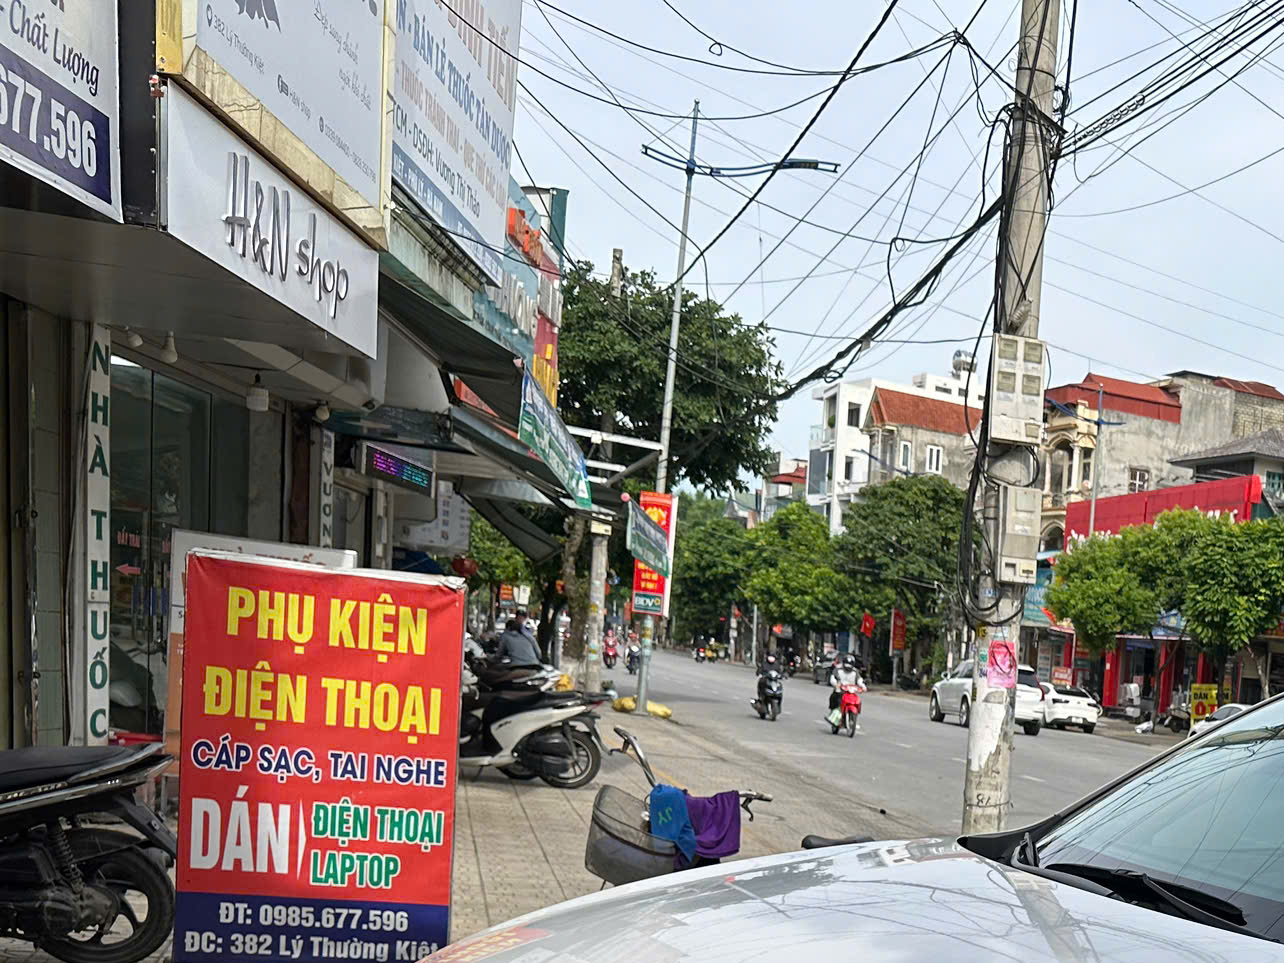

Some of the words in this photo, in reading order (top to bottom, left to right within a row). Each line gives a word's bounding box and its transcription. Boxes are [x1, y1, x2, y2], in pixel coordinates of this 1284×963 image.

[9, 0, 48, 54] Chất
[53, 28, 100, 97] Lượng
[213, 15, 225, 36] 382
[413, 13, 433, 70] BÁN
[222, 152, 291, 282] H&N
[296, 213, 349, 320] shop
[90, 341, 110, 477] NHÀ
[89, 509, 110, 740] THUỐC
[226, 585, 315, 655] PHỤ
[328, 592, 428, 663] KIỆN
[203, 661, 308, 731] ĐIỆN
[321, 677, 442, 744] THOẠI
[192, 734, 252, 771] CÁP
[258, 745, 322, 784] SẠC,
[329, 751, 368, 781] TAI
[374, 755, 446, 787] NGHE
[189, 784, 292, 875] DÁN
[312, 798, 369, 847] ĐIỆN
[374, 808, 445, 851] THOẠI
[311, 851, 401, 889] LAPTOP
[184, 931, 223, 955] ĐC:
[230, 933, 272, 957] 382
[279, 935, 302, 961] Lý
[311, 936, 389, 963] Thường
[219, 901, 252, 926] ĐT:
[259, 903, 409, 932] 0985.677.596
